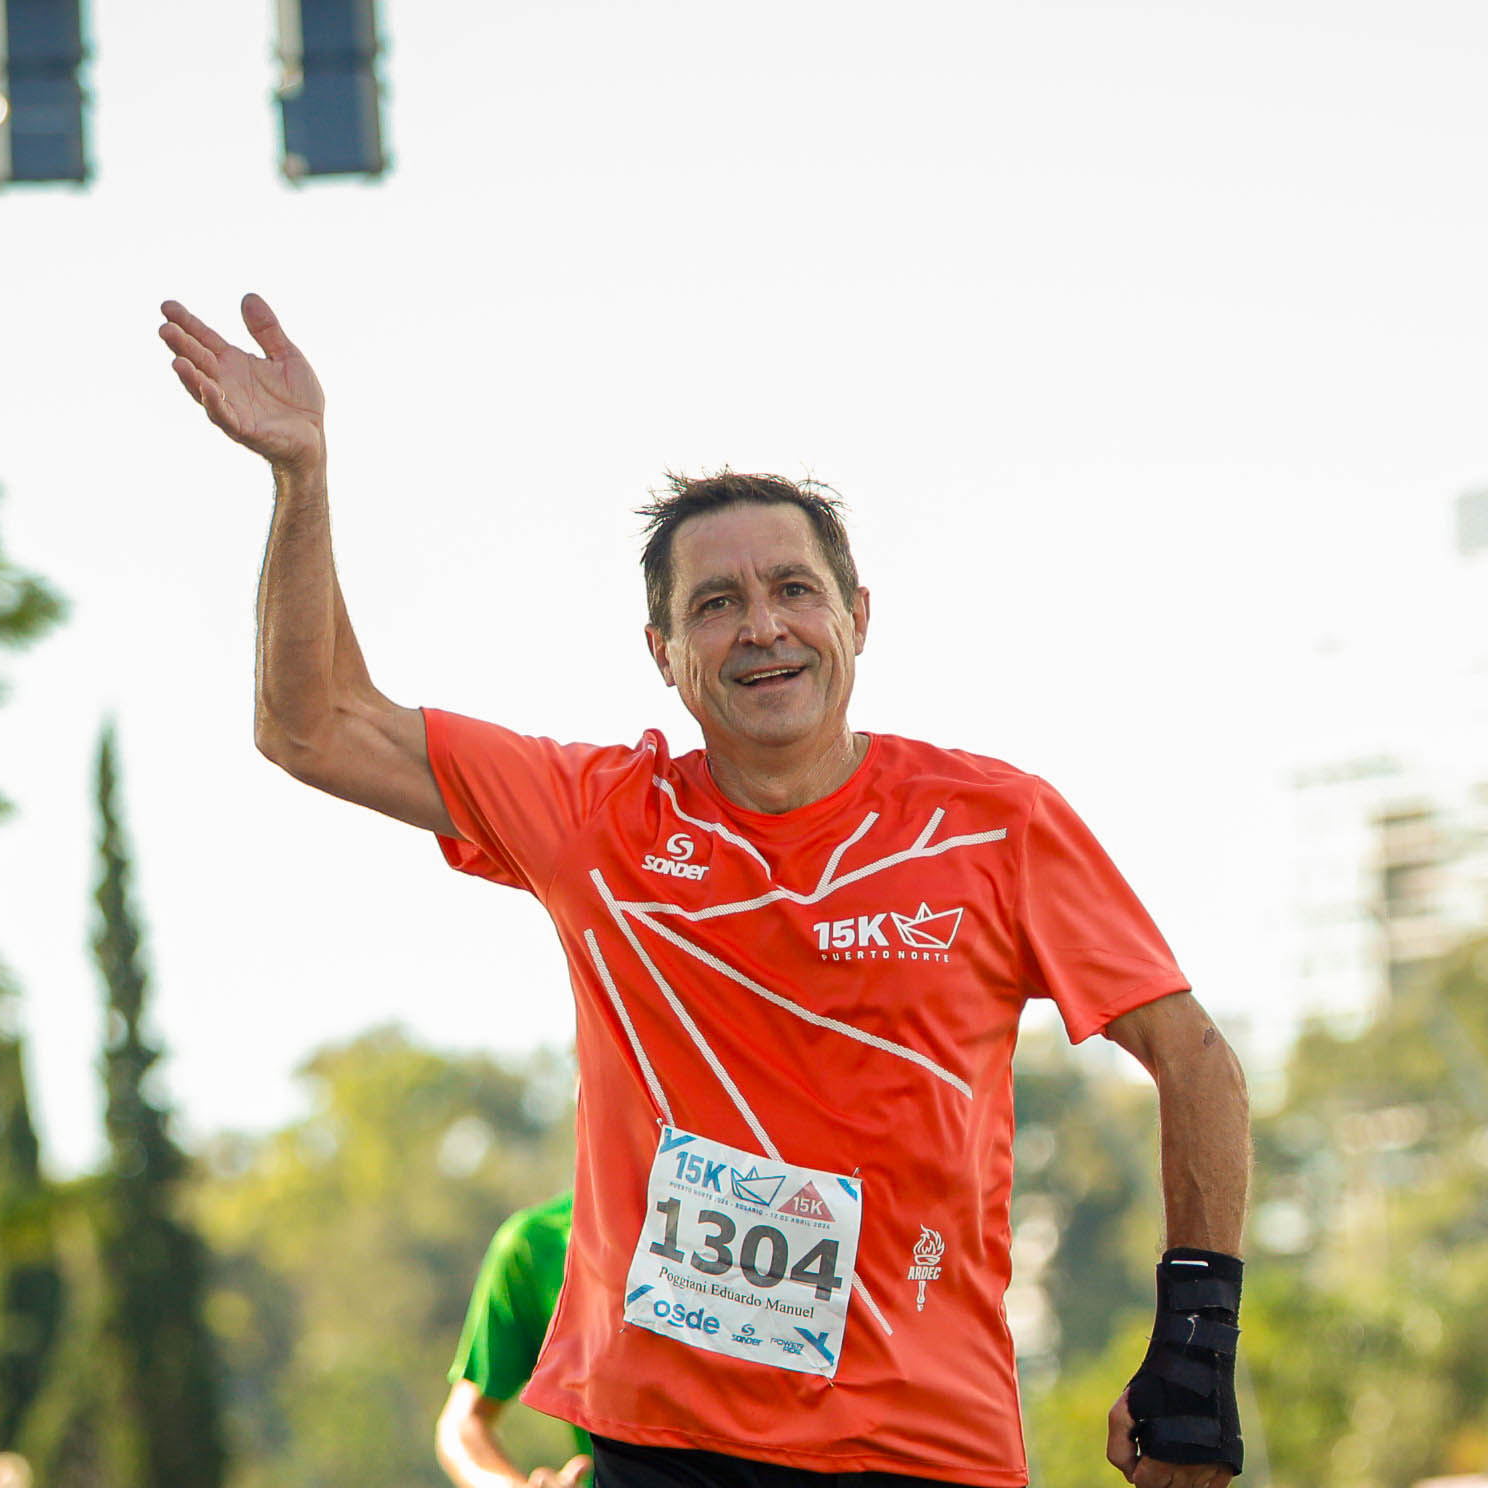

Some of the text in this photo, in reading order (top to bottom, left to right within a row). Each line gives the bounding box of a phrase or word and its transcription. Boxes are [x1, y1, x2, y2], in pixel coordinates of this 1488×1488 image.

[813, 913, 890, 950] 15K
[821, 950, 950, 963] PUERTO NORTE
[676, 1151, 727, 1193] 15K
[793, 1196, 824, 1216] 15K
[649, 1197, 843, 1301] 1304
[908, 1266, 942, 1280] ARDEC
[659, 1266, 814, 1319] Poggiani Eduardo Manuel
[653, 1300, 721, 1334] osde
